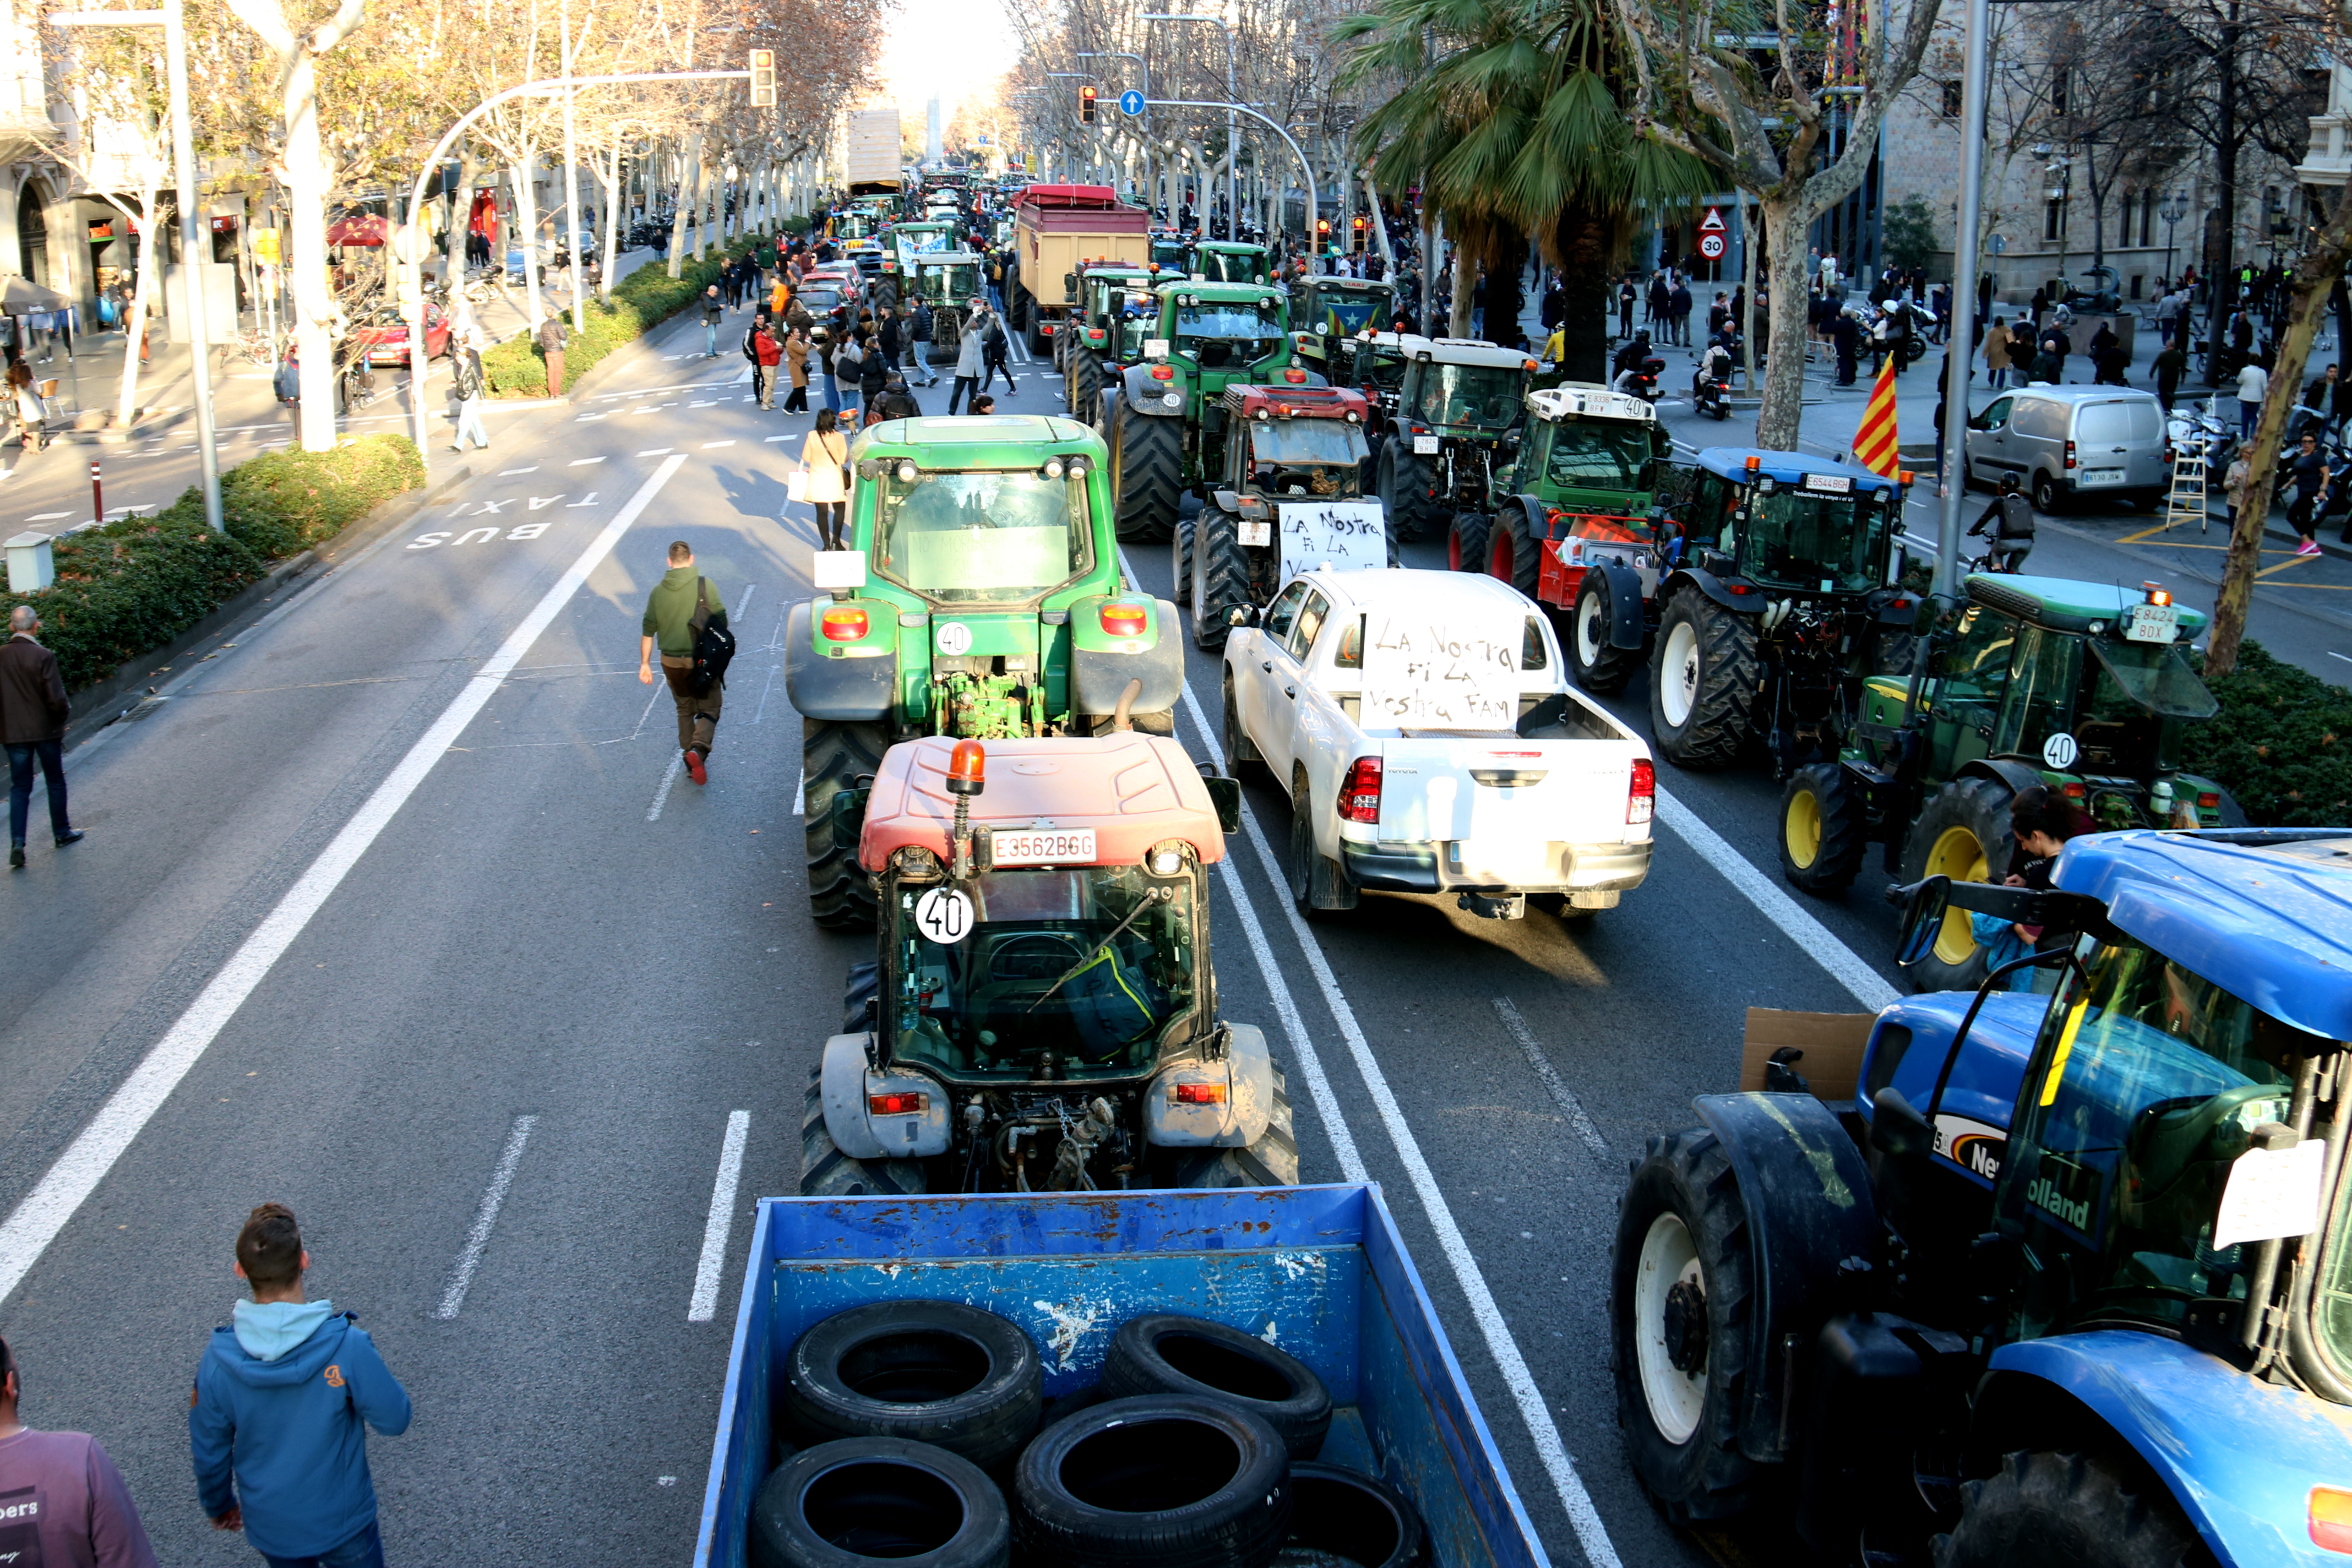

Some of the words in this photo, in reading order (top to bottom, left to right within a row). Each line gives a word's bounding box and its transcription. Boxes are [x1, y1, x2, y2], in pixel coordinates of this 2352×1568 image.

[1705, 241, 1721, 251] 30
[1256, 275, 1263, 284] 40
[1318, 324, 1326, 333] 40
[1593, 395, 1610, 404] 8336
[1626, 399, 1642, 415] 40
[446, 491, 600, 518] TAXI
[405, 521, 552, 549] BUS
[1283, 515, 1309, 533] LA
[912, 536, 931, 553] NO
[1326, 535, 1349, 557] LA
[2133, 607, 2142, 620] E
[2143, 608, 2175, 623] 8424
[943, 627, 963, 651] 40
[1375, 617, 1411, 652] LA
[2139, 624, 2163, 639] BDX
[1444, 662, 1477, 688] LA
[1464, 693, 1509, 722] FAM
[2046, 737, 2071, 765] 40
[1387, 766, 1418, 775] TOYOTA
[995, 836, 1092, 858] E3562BGG
[925, 895, 962, 937] 40
[2027, 1177, 2090, 1231] olland
